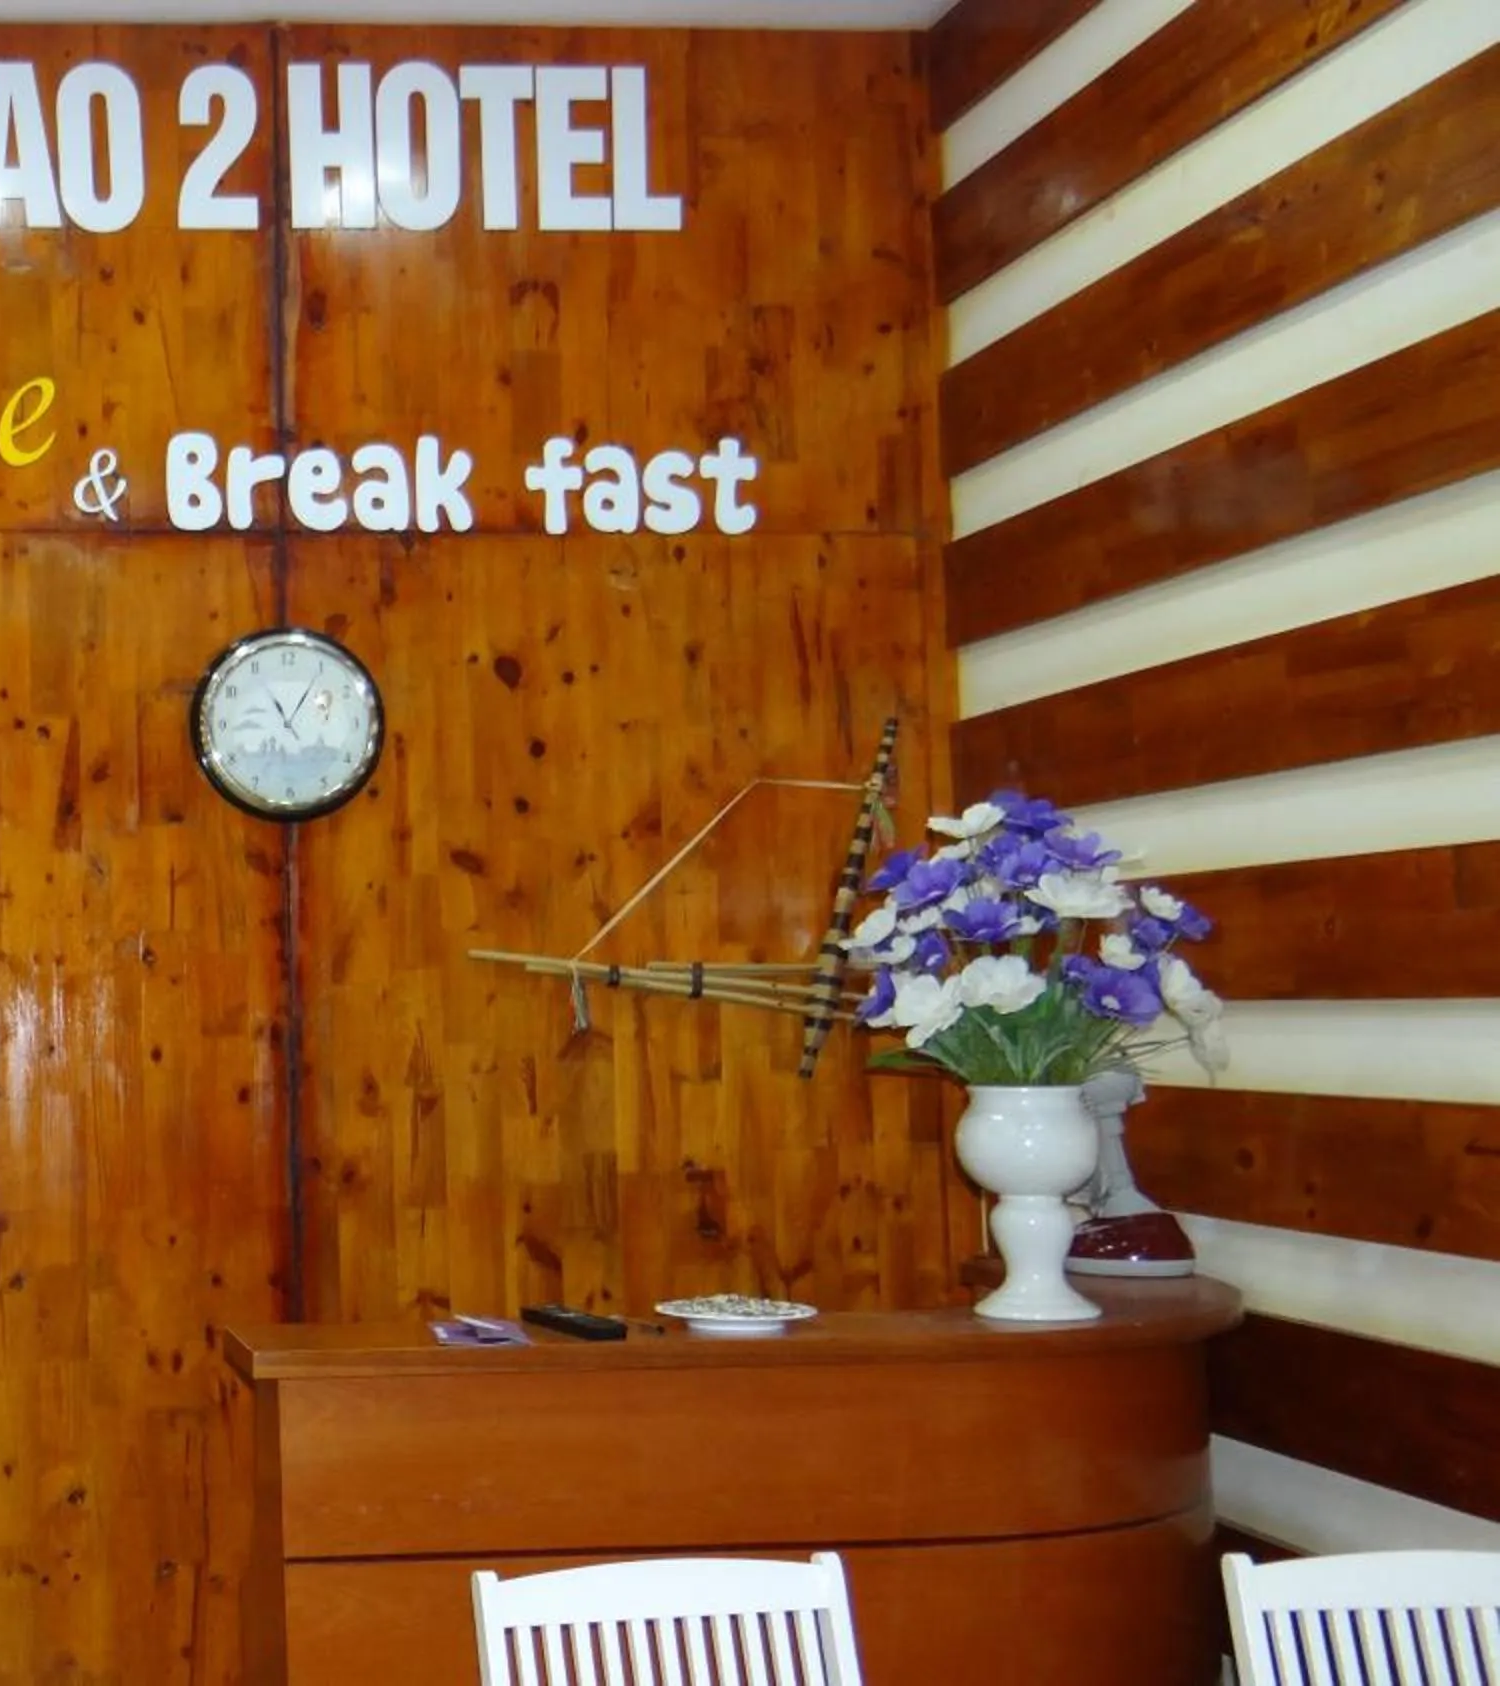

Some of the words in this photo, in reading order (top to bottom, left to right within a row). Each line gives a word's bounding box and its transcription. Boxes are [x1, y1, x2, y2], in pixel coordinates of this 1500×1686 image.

[178, 64, 259, 230] 2
[287, 61, 682, 231] HOTEL
[73, 449, 128, 522] &
[165, 432, 473, 533] Break
[525, 437, 757, 535] fast
